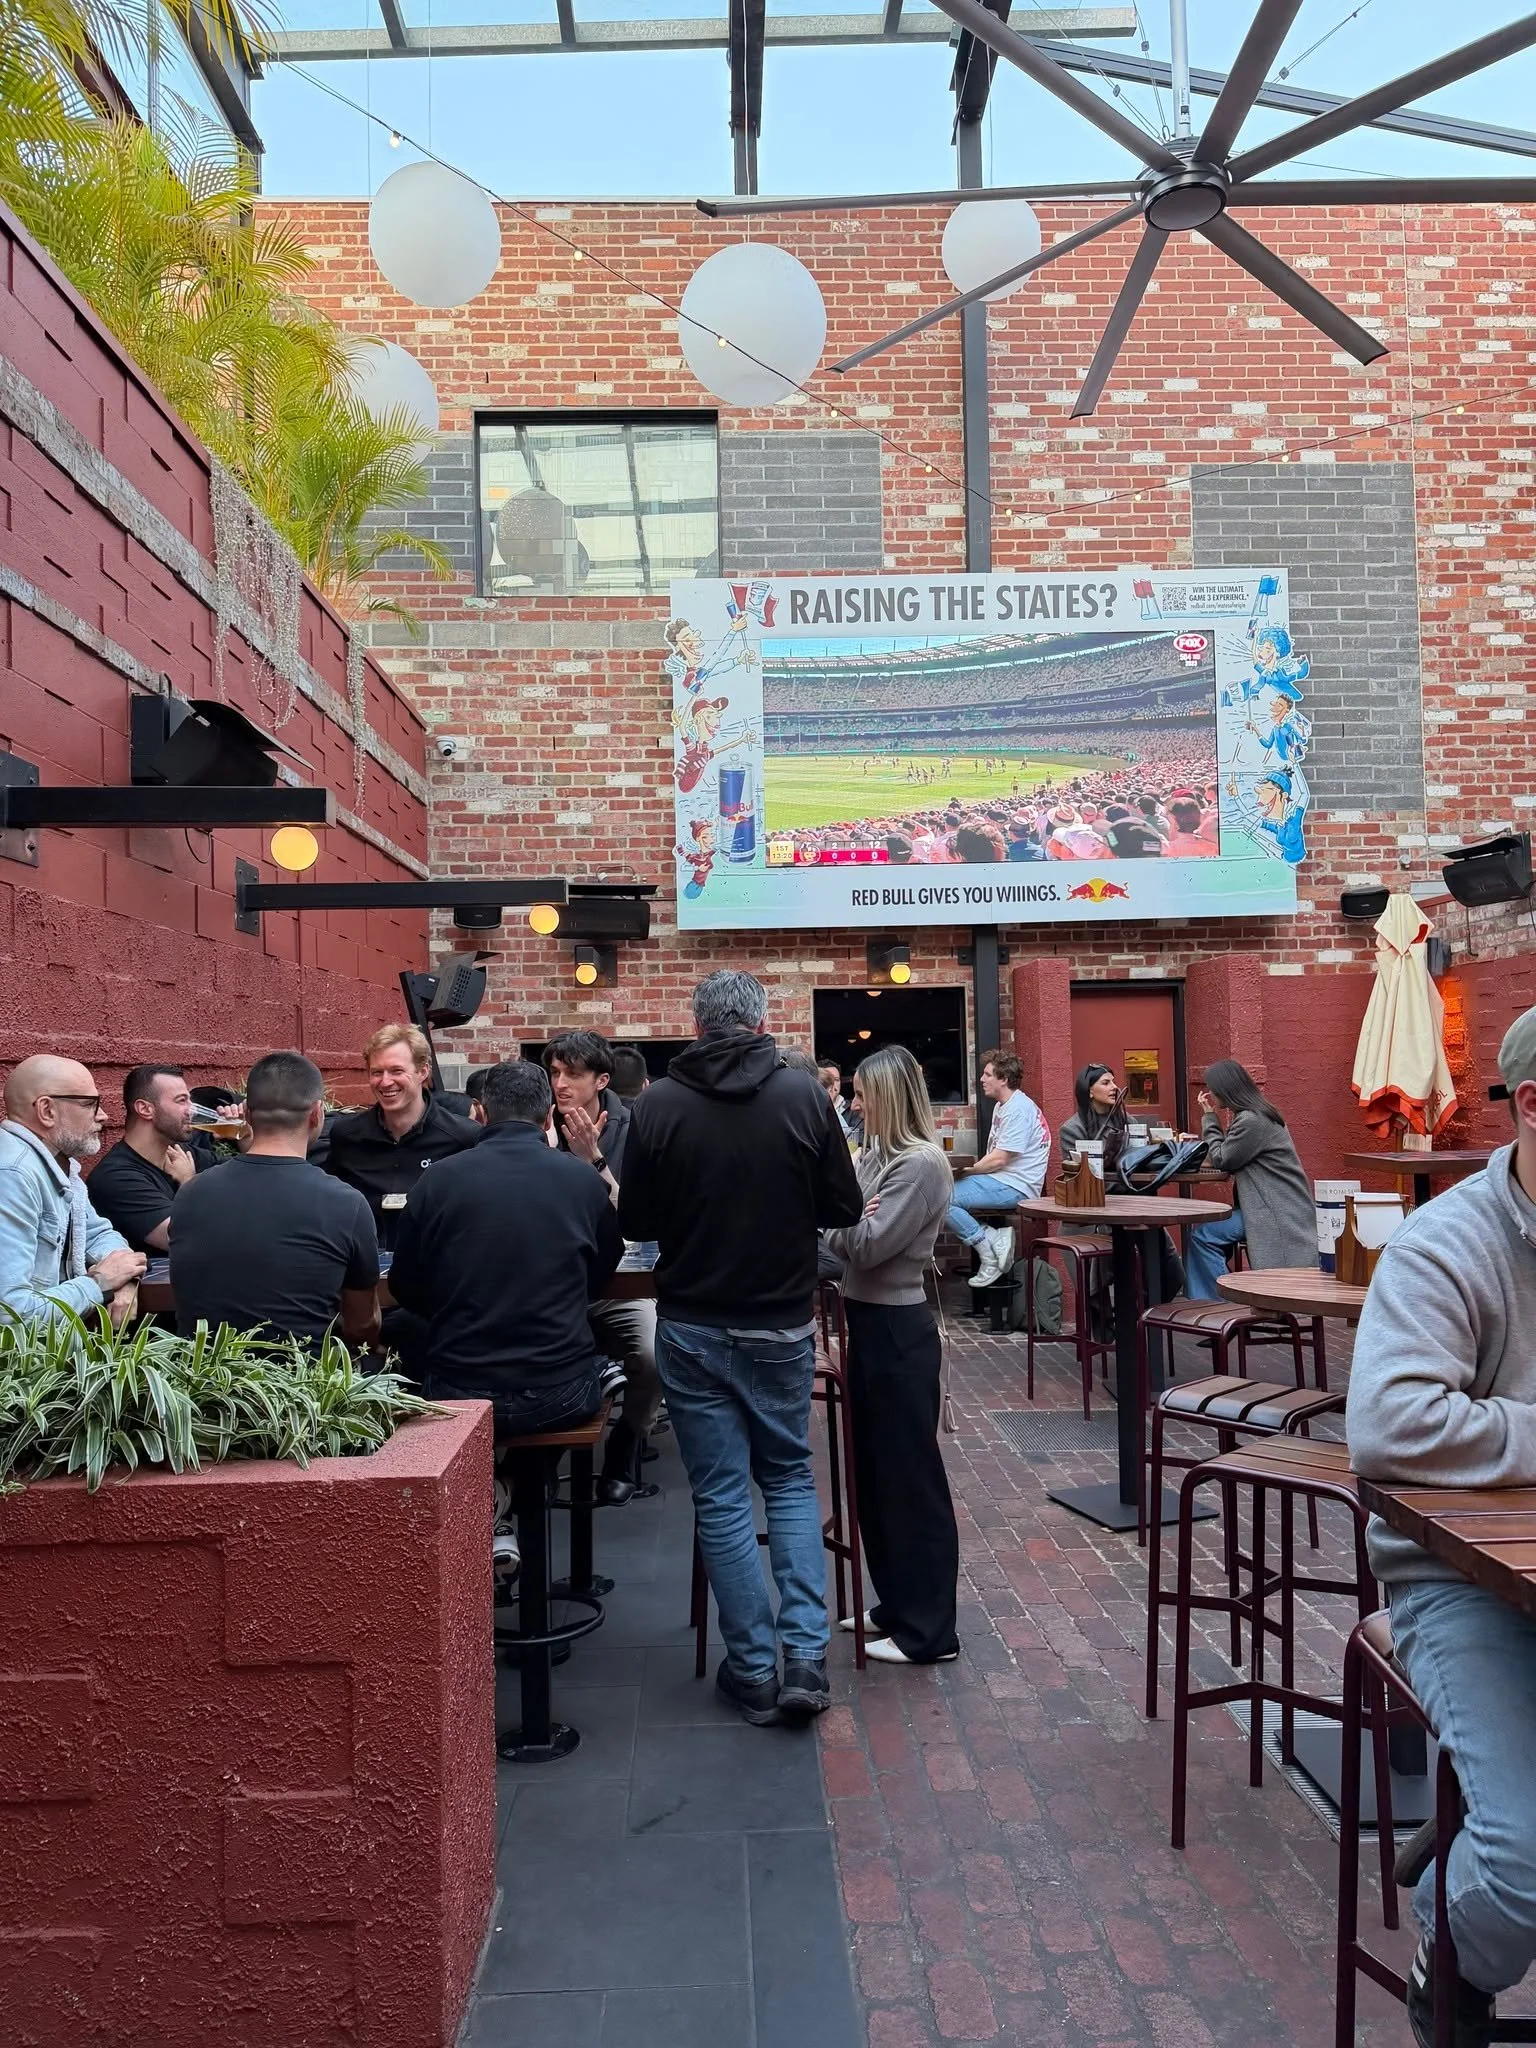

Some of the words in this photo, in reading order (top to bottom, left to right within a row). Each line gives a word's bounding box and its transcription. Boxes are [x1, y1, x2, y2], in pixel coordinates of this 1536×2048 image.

[790, 587, 920, 624] RAISING
[929, 585, 985, 621] THE
[996, 583, 1117, 620] STATES?
[1179, 638, 1201, 648] FOX
[851, 889, 879, 906] RED
[882, 888, 915, 905] BULL
[918, 887, 959, 905] GIVES
[963, 886, 993, 903] YOU
[996, 884, 1061, 903] WIIINGS.
